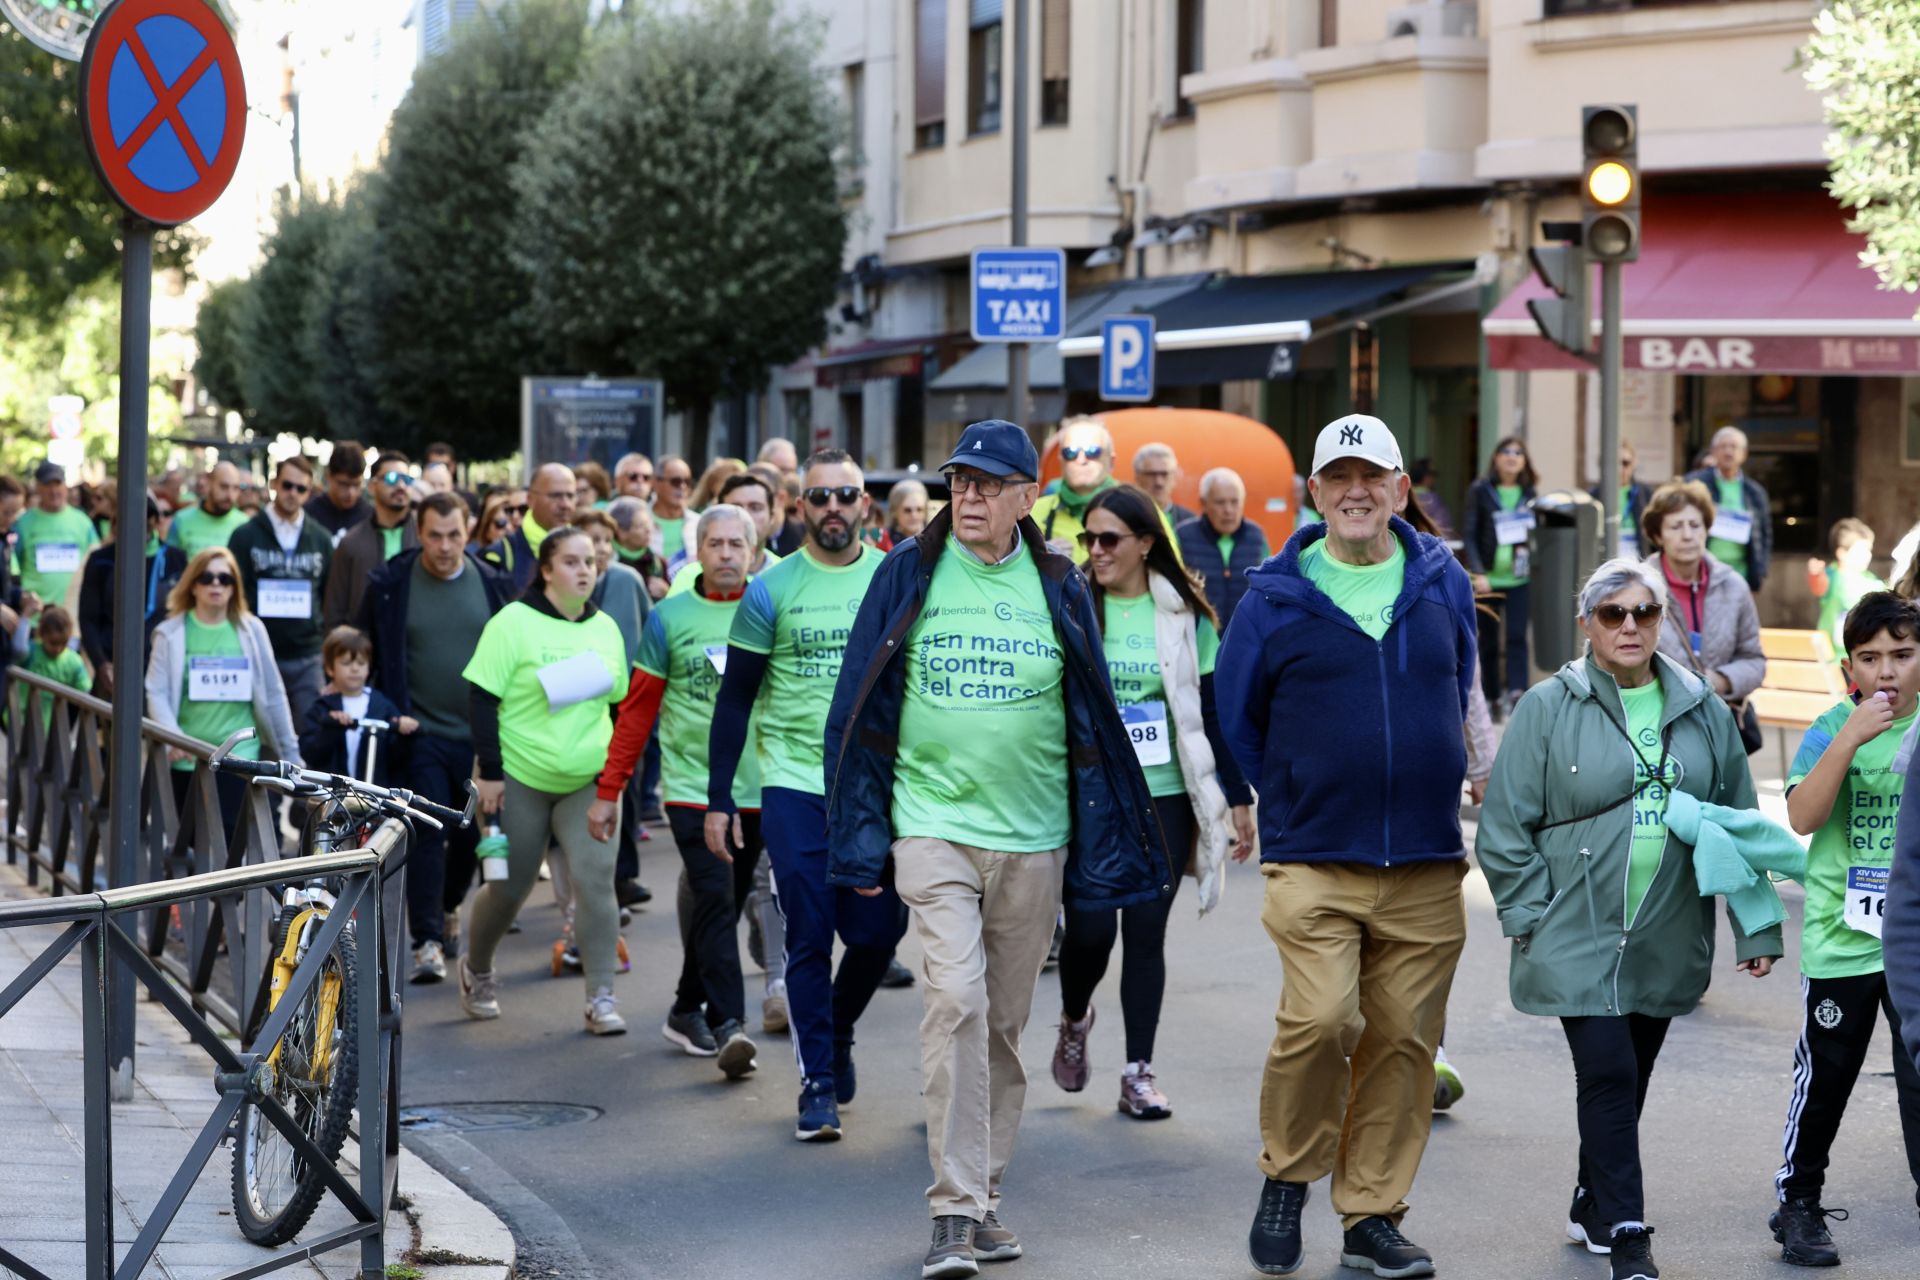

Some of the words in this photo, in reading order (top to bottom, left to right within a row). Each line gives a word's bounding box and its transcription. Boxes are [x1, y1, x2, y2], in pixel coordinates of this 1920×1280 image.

[986, 300, 1051, 323] TAXI
[1110, 325, 1143, 389] P
[1639, 338, 1756, 369] BAR
[1339, 424, 1363, 446] NY
[941, 606, 987, 616] Iberdrola
[801, 627, 826, 643] En
[933, 632, 963, 649] En
[804, 663, 822, 678] el
[929, 655, 1015, 677] contra
[930, 676, 953, 697] el
[1131, 726, 1158, 743] 98
[1856, 791, 1882, 808] En
[1854, 812, 1898, 829] con
[1853, 832, 1874, 850] el
[1856, 869, 1870, 877] XIV
[1855, 882, 1878, 890] contra
